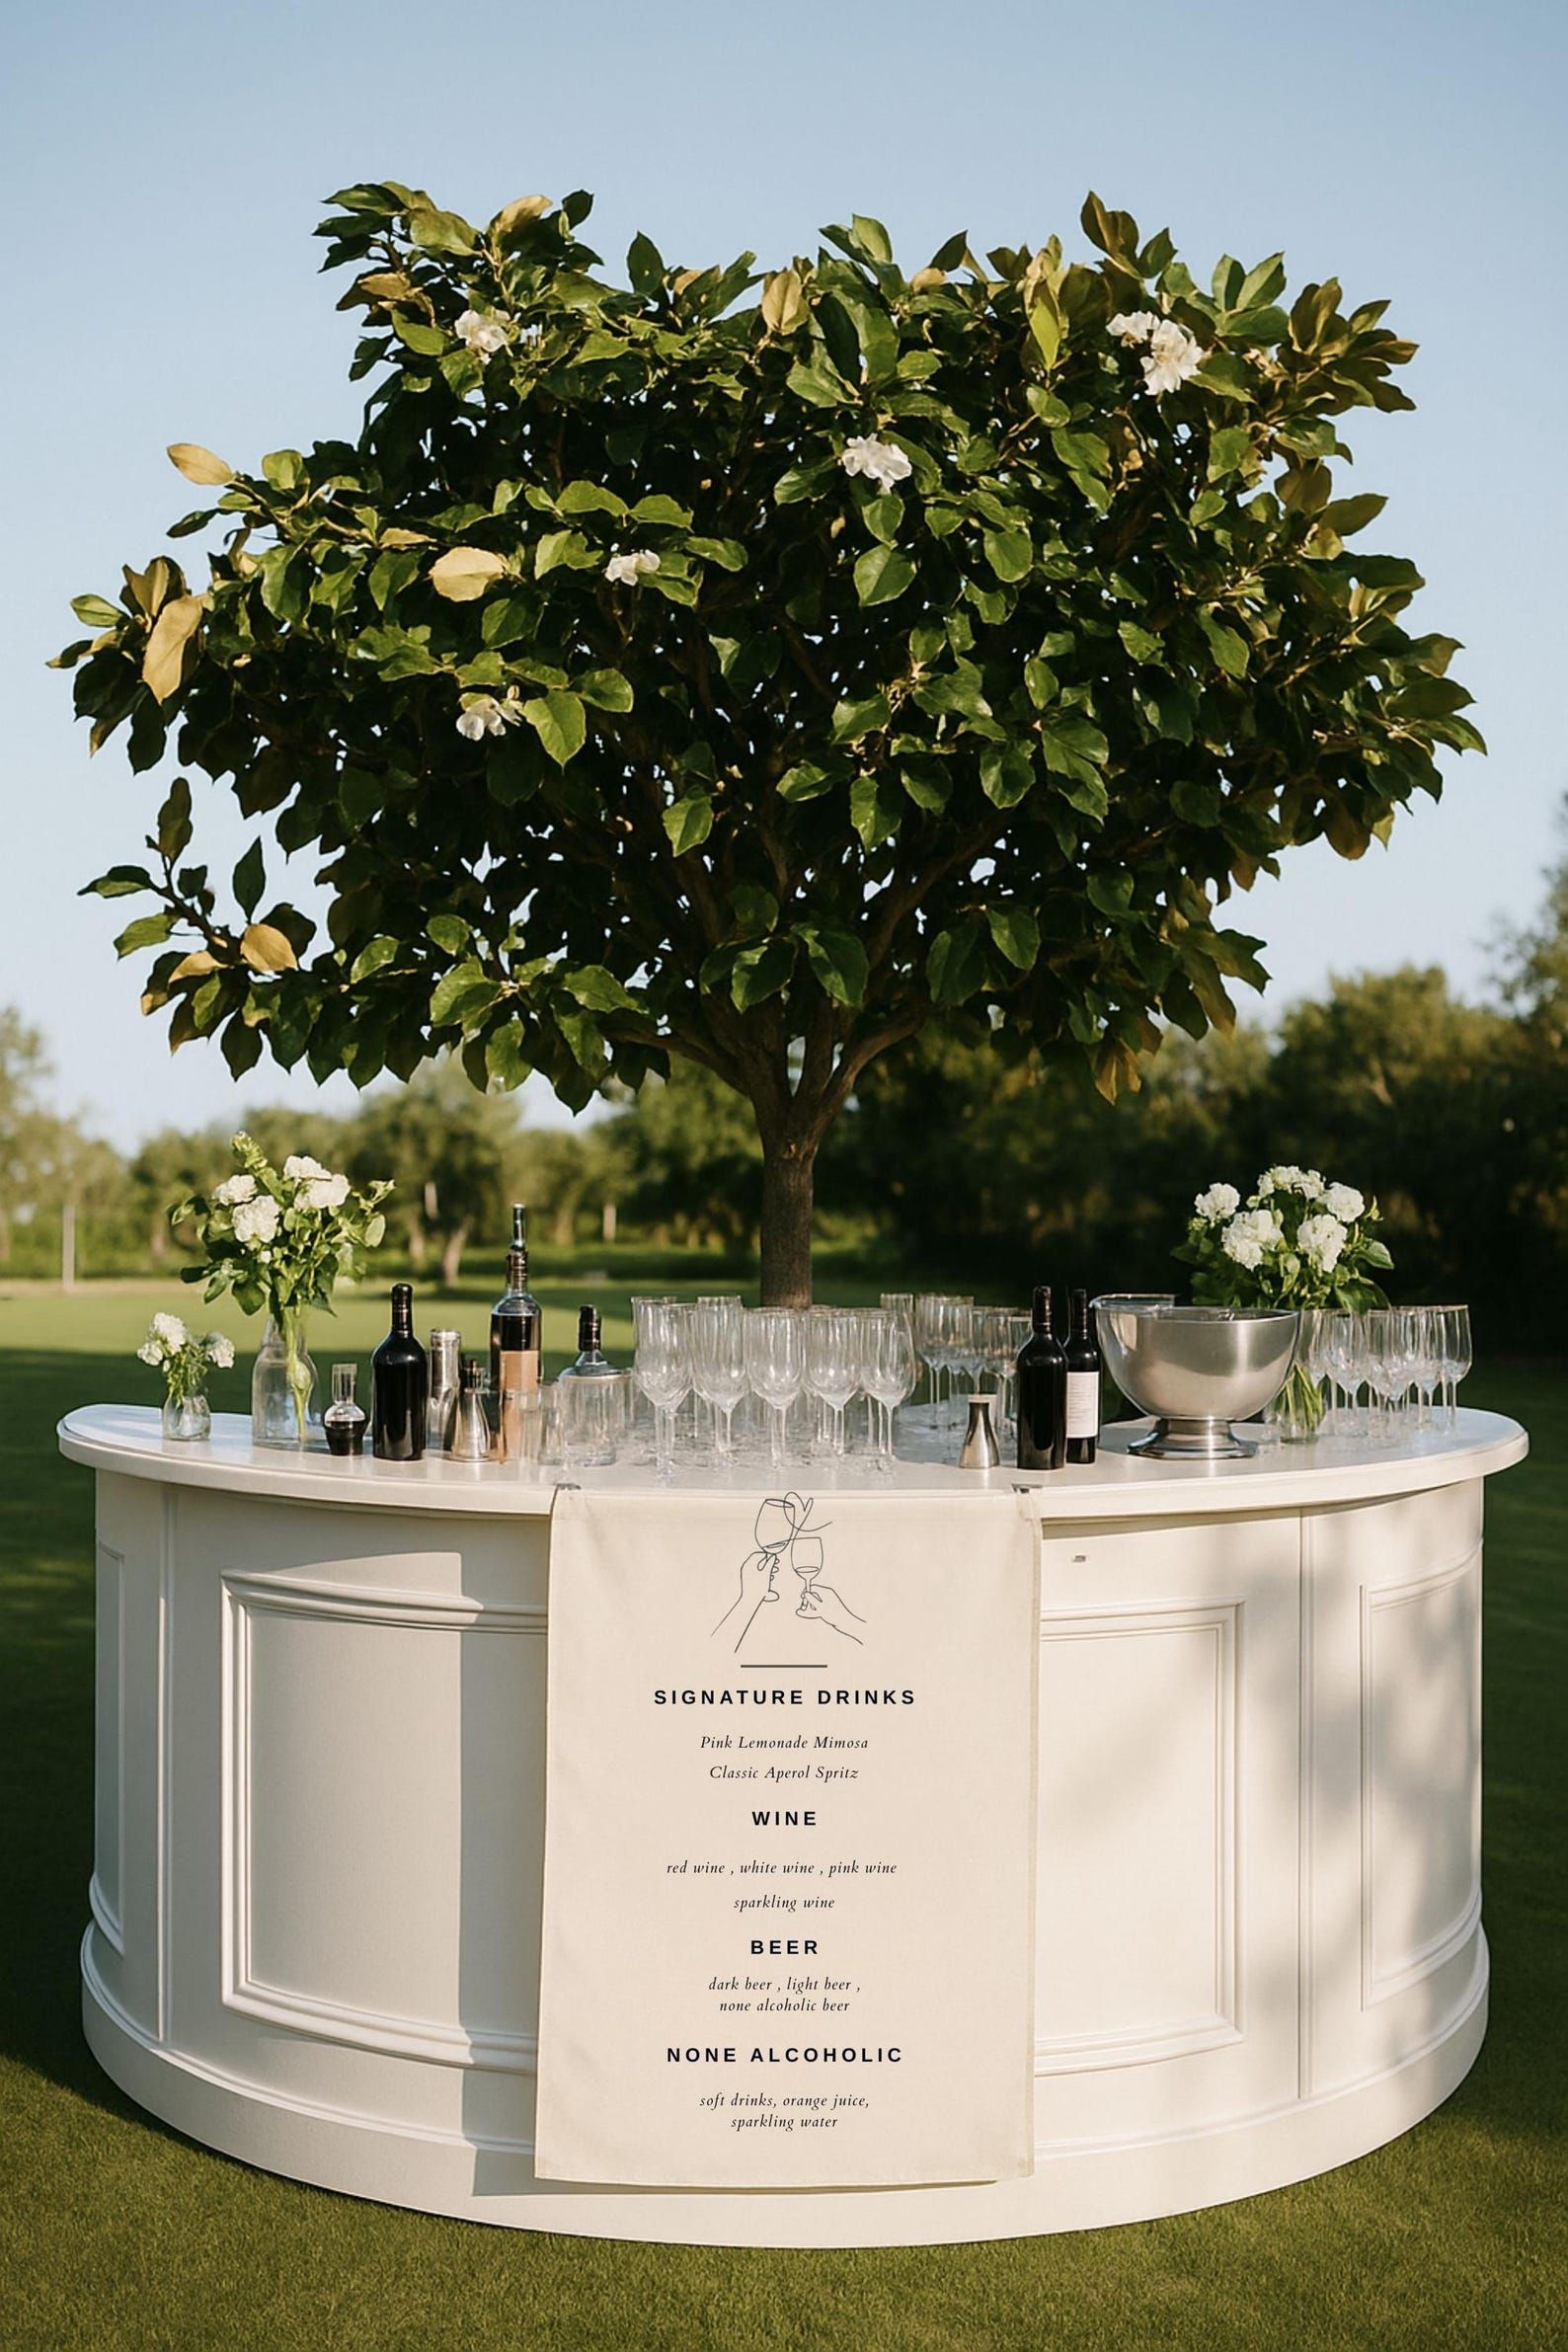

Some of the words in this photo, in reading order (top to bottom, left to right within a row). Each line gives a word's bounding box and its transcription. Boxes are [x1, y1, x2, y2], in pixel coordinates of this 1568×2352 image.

[655, 1690, 803, 1704] SIGNATURE
[819, 1690, 913, 1704] DRINKS
[700, 1735, 732, 1748] Pink
[738, 1735, 808, 1748] Lemonade
[814, 1736, 868, 1749] Mimosa
[710, 1765, 758, 1778] Classic
[764, 1764, 810, 1783] Aperol
[816, 1766, 858, 1783] Spritz
[751, 1811, 816, 1826] WINE
[667, 1860, 687, 1873] red
[741, 1860, 777, 1873] white
[828, 1860, 859, 1878] pink
[866, 1861, 897, 1873] wine
[734, 1895, 797, 1913] sparkling
[804, 1896, 834, 1908] wine
[751, 1940, 818, 1954] BEER
[709, 1977, 739, 1990] dark
[787, 1977, 818, 1995] light
[720, 2002, 750, 2011] none
[757, 1998, 817, 2011] alcoholic
[823, 1998, 849, 2011] beer
[667, 2048, 736, 2063] NONE
[750, 2048, 901, 2063] ALCOHOLIC
[699, 2092, 725, 2110] soft
[731, 2092, 776, 2108] drinks,
[783, 2098, 827, 2110] orange
[830, 2094, 868, 2110] juice,
[731, 2114, 794, 2132] sparkling
[801, 2118, 837, 2127] water
